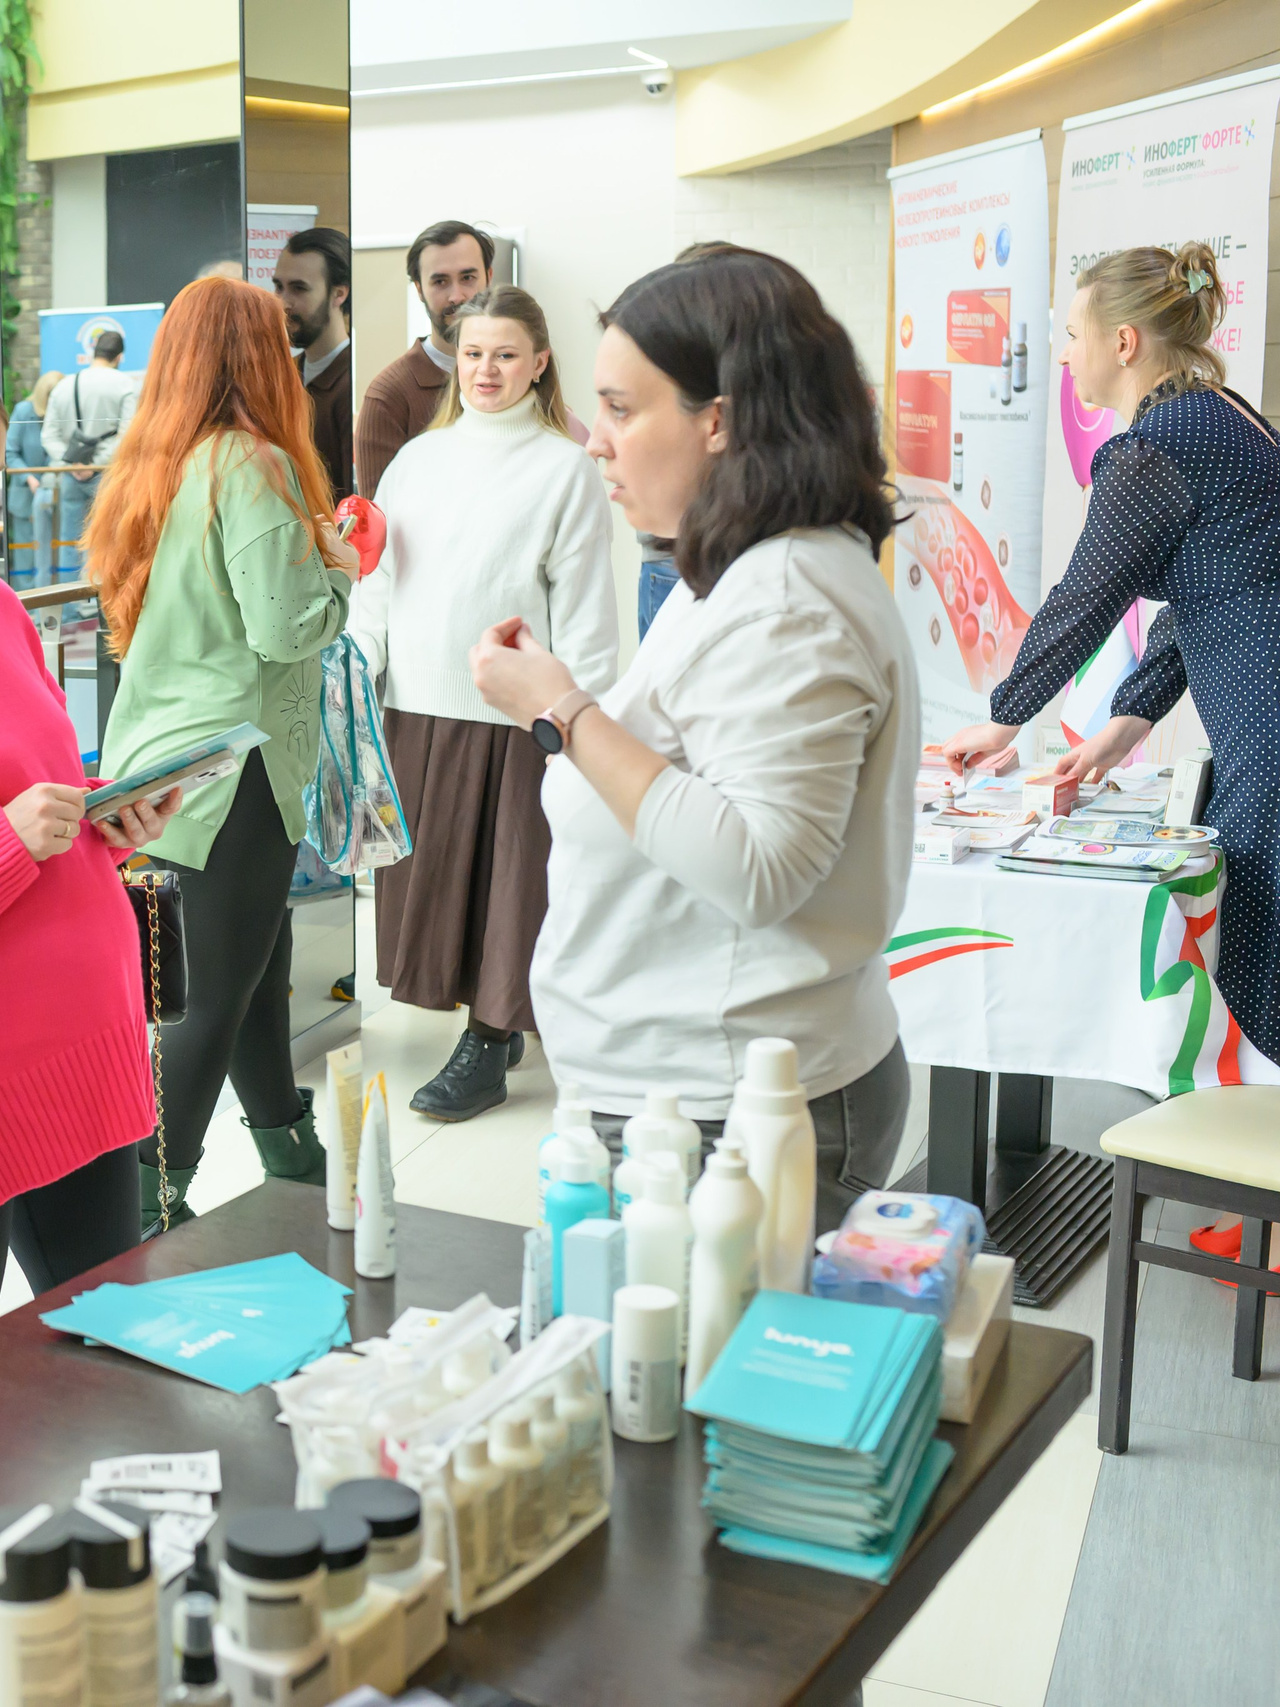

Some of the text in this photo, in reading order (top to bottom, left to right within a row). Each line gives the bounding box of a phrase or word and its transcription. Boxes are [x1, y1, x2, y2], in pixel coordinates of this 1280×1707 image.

[1144, 125, 1242, 163] ИНОФЕРТ ФОРТЕ
[1071, 152, 1120, 178] ИНОФЕРТ
[1143, 165, 1175, 179] УСИЛЕННАЯ
[969, 192, 1011, 212] КОМПЛЕКСЫ
[896, 226, 961, 249] НОВОГО ПОКОЛЕНИЯ
